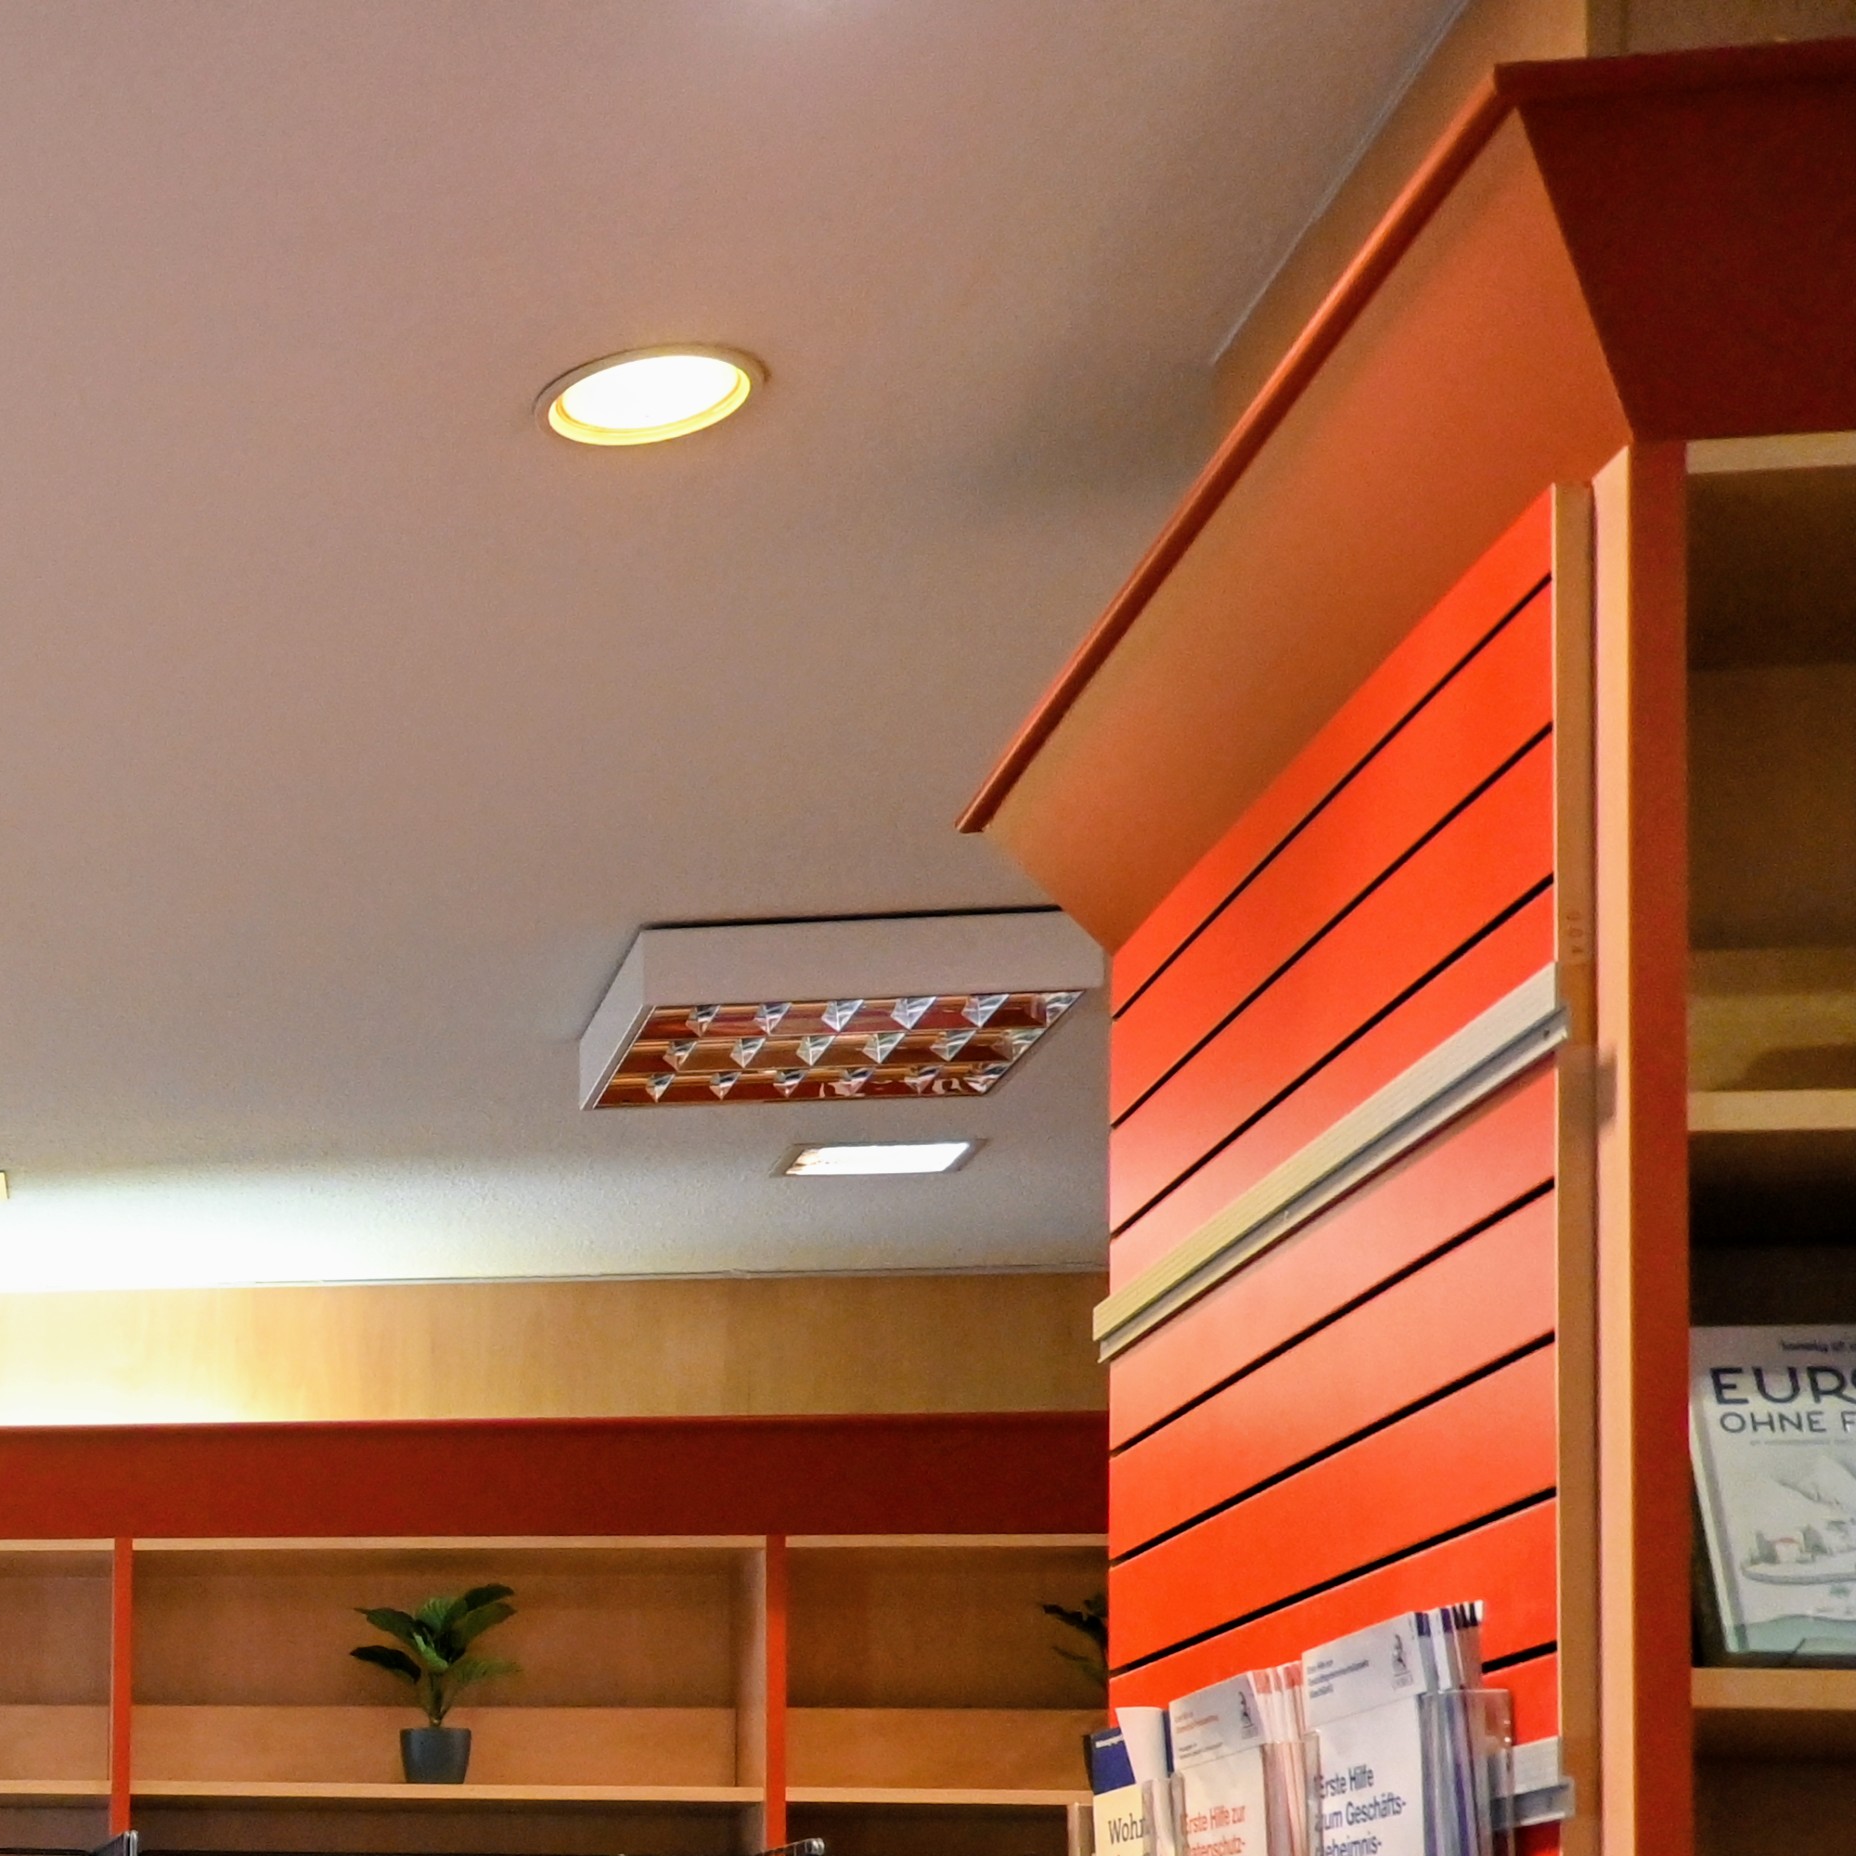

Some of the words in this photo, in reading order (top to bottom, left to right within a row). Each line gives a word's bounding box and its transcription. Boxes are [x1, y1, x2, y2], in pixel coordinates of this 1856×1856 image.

[1710, 1366, 1856, 1405] EUR
[1720, 1411, 1827, 1434] OHNE
[1314, 1774, 1346, 1799] Erste
[1349, 1764, 1374, 1793] Hilfe
[1184, 1811, 1208, 1833] Erste
[1209, 1804, 1230, 1828] Hilfe
[1232, 1805, 1246, 1825] zur
[1345, 1793, 1407, 1828] Geschäfts-
